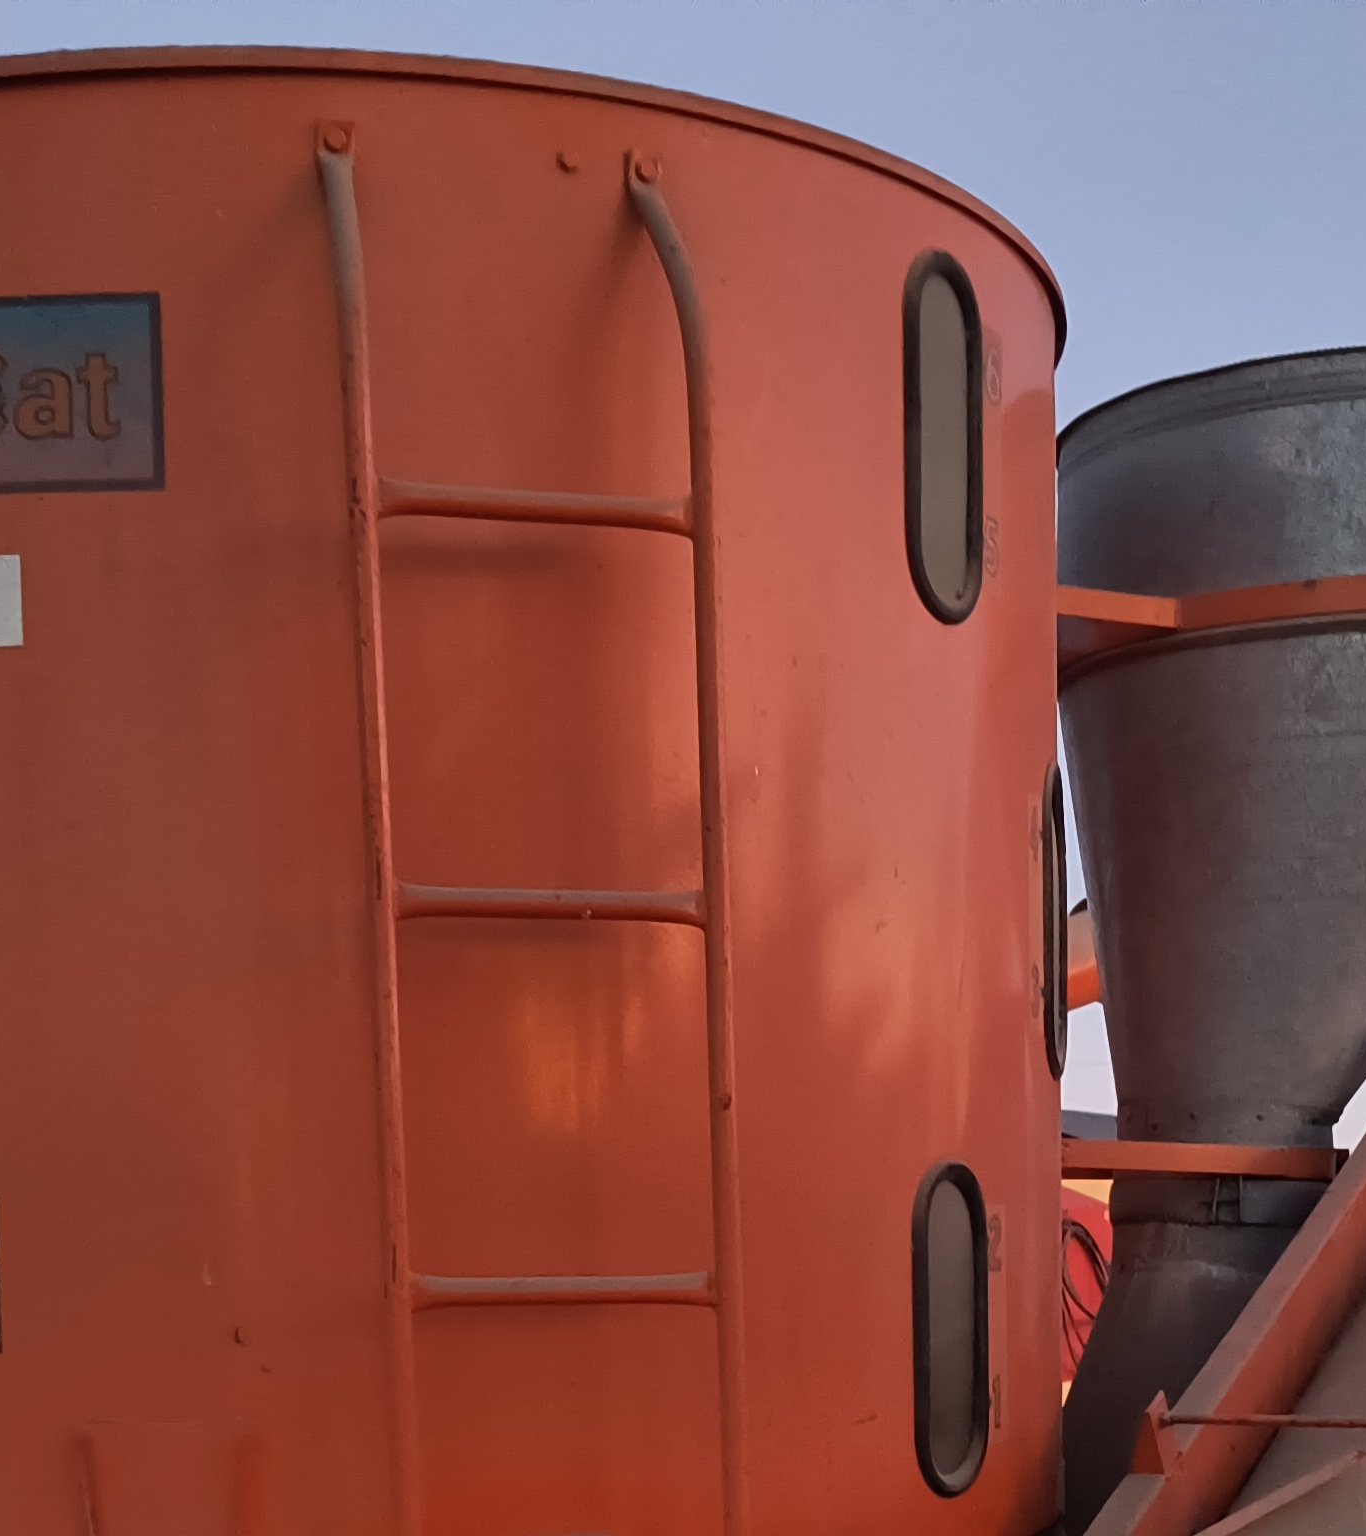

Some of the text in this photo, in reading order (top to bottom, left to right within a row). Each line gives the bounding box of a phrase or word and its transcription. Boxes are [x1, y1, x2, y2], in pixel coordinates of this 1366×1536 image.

[985, 346, 1002, 407] 6
[988, 1214, 1003, 1272] 2
[991, 1374, 1002, 1429] 1
